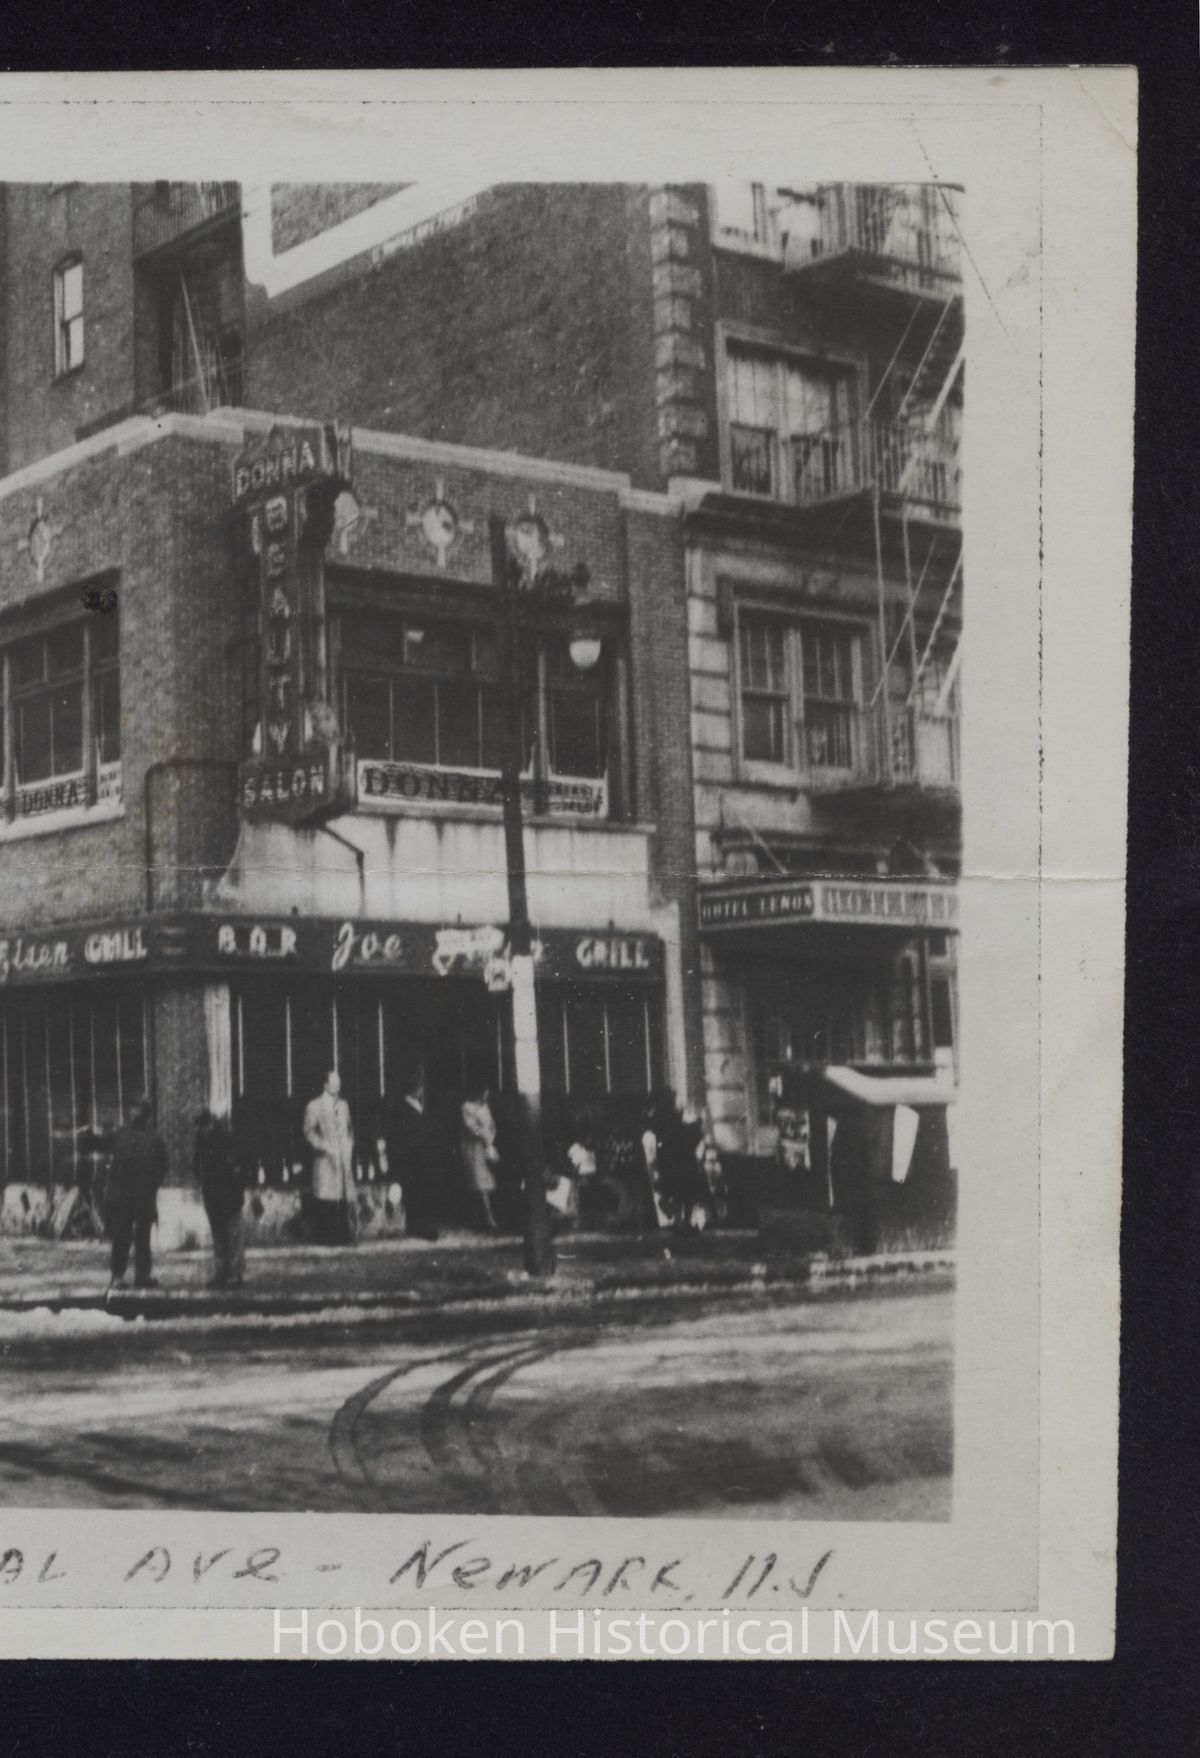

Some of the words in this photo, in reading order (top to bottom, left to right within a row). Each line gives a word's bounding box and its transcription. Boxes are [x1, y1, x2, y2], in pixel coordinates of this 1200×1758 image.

[244, 764, 324, 808] SALON
[84, 928, 148, 964] GRILL
[217, 923, 298, 958] BAR
[330, 920, 402, 972] Joe
[575, 938, 649, 968] GRILL
